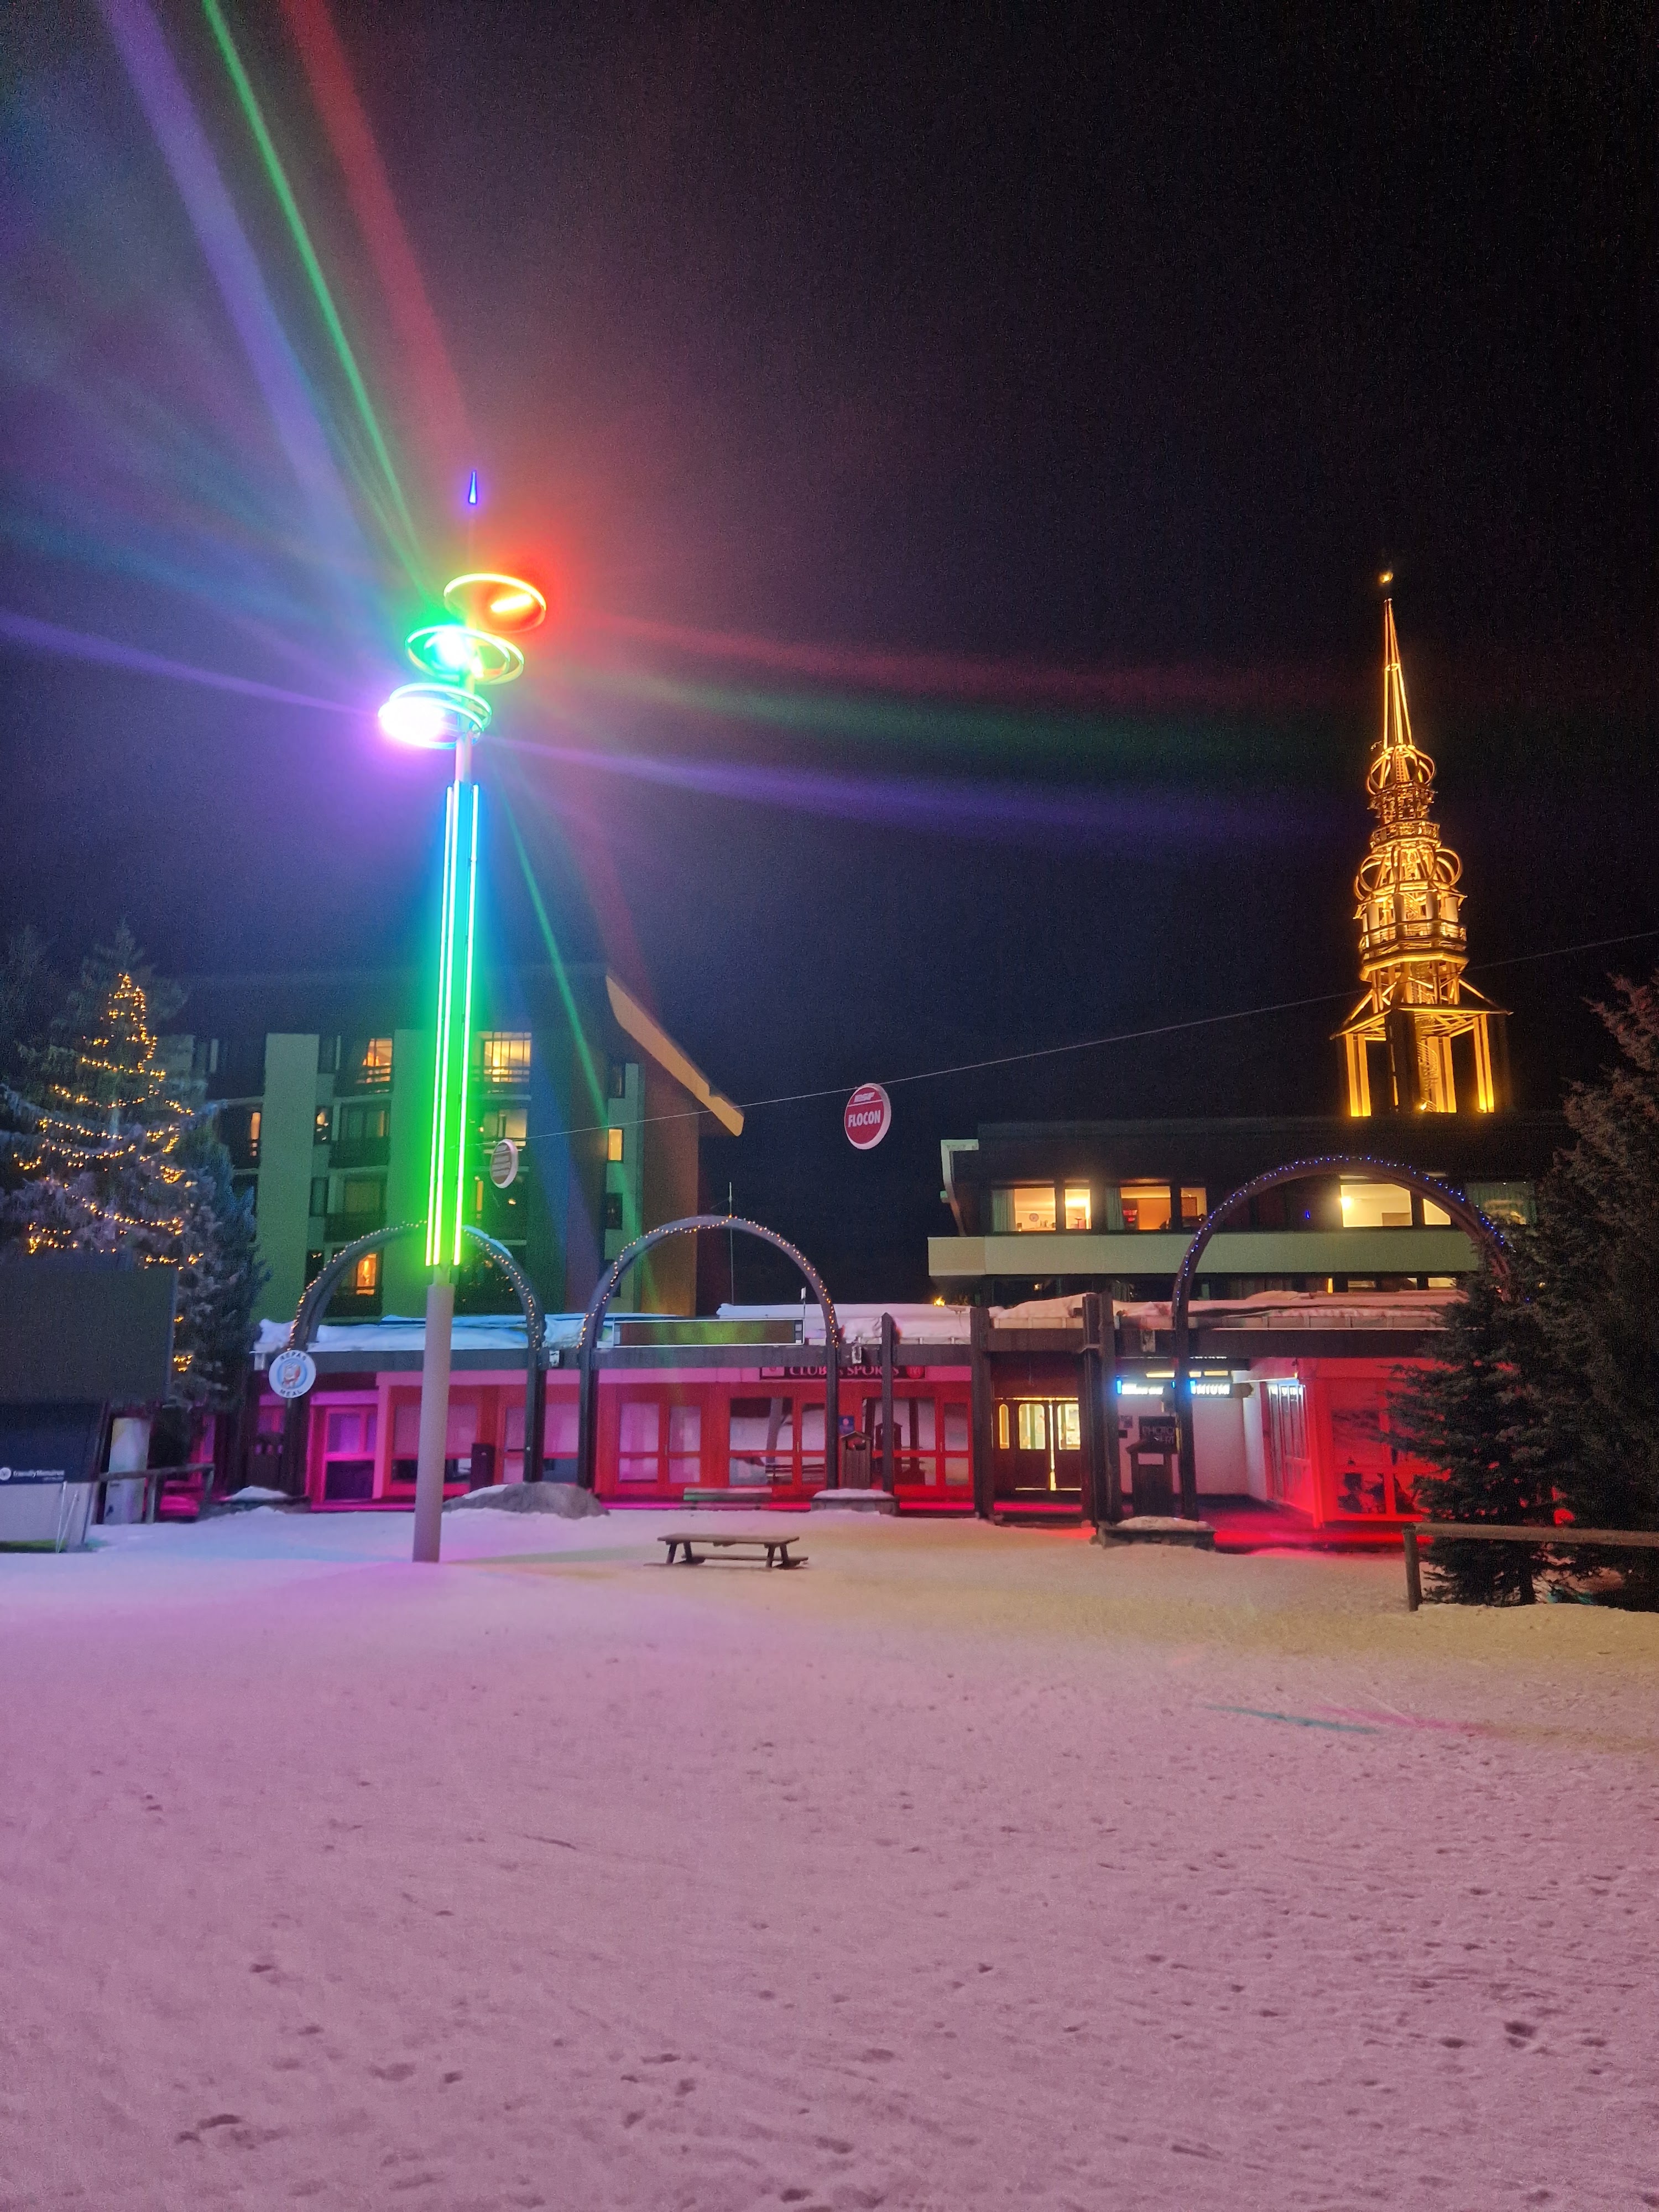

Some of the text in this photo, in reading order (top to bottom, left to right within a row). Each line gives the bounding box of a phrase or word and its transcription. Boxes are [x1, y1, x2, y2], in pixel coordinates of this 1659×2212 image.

[848, 1109, 881, 1128] FLOCON
[847, 1366, 899, 1375] SPORS
[280, 1389, 302, 1397] MEAL
